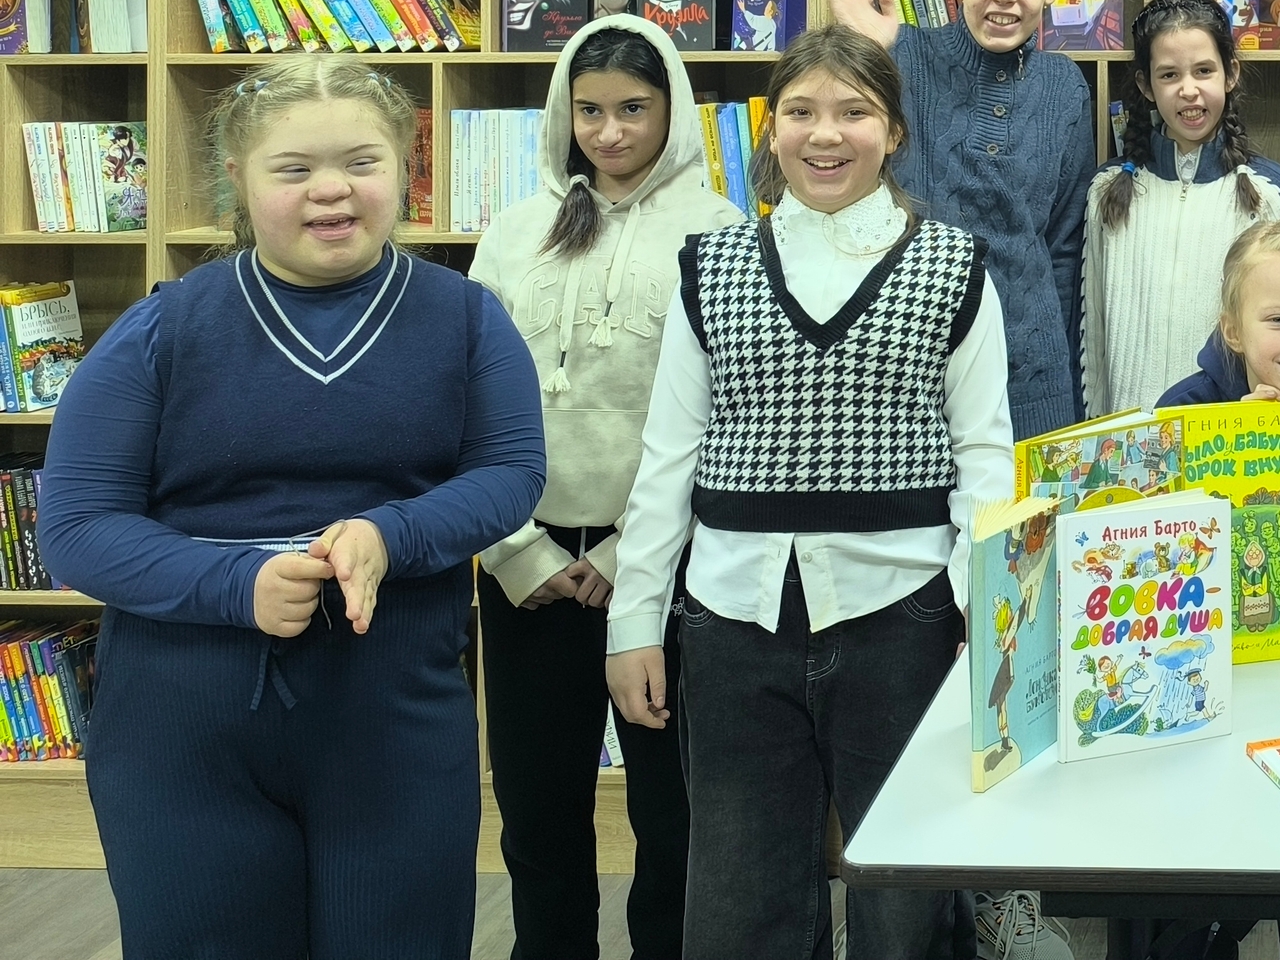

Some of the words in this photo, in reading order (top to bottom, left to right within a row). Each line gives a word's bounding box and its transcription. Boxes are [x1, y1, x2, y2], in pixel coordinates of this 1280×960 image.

[20, 300, 70, 322] БРЫСЬ,
[1186, 418, 1244, 433] ГНИЯ
[1184, 438, 1224, 463] ЫЛО
[1016, 457, 1025, 489] Агния
[1184, 459, 1236, 483] ОРОК
[1102, 524, 1147, 541] Агния
[1154, 520, 1197, 537] Барто
[1071, 616, 1158, 650] ДОБРАЯ
[1160, 608, 1222, 638] ДУША
